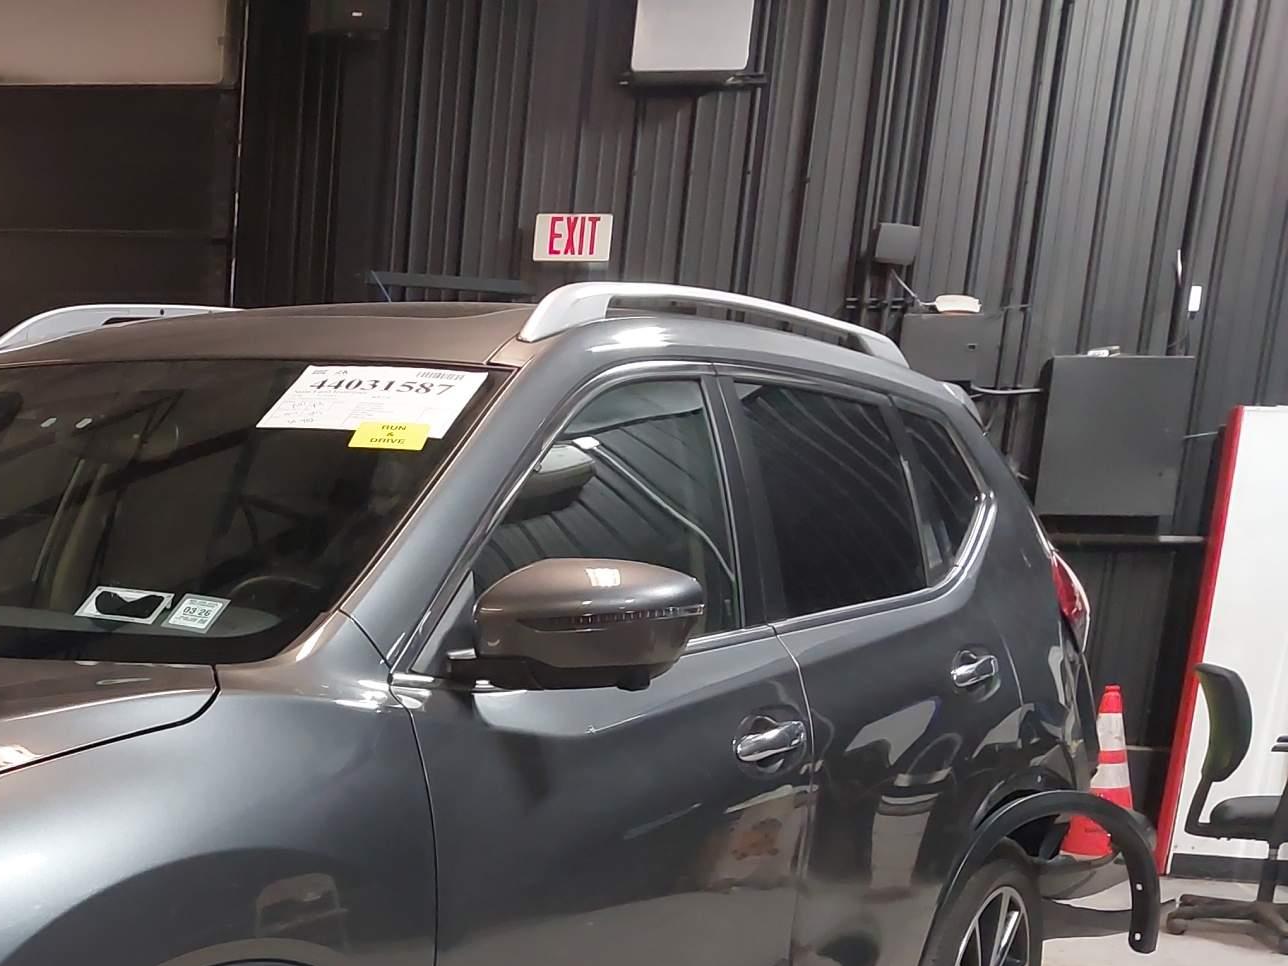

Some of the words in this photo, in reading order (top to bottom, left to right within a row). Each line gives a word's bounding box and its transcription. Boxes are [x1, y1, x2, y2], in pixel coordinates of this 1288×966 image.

[548, 216, 601, 255] EXIT
[309, 378, 455, 396] 44031587
[369, 437, 406, 445] DRIVE
[183, 606, 197, 614] 03
